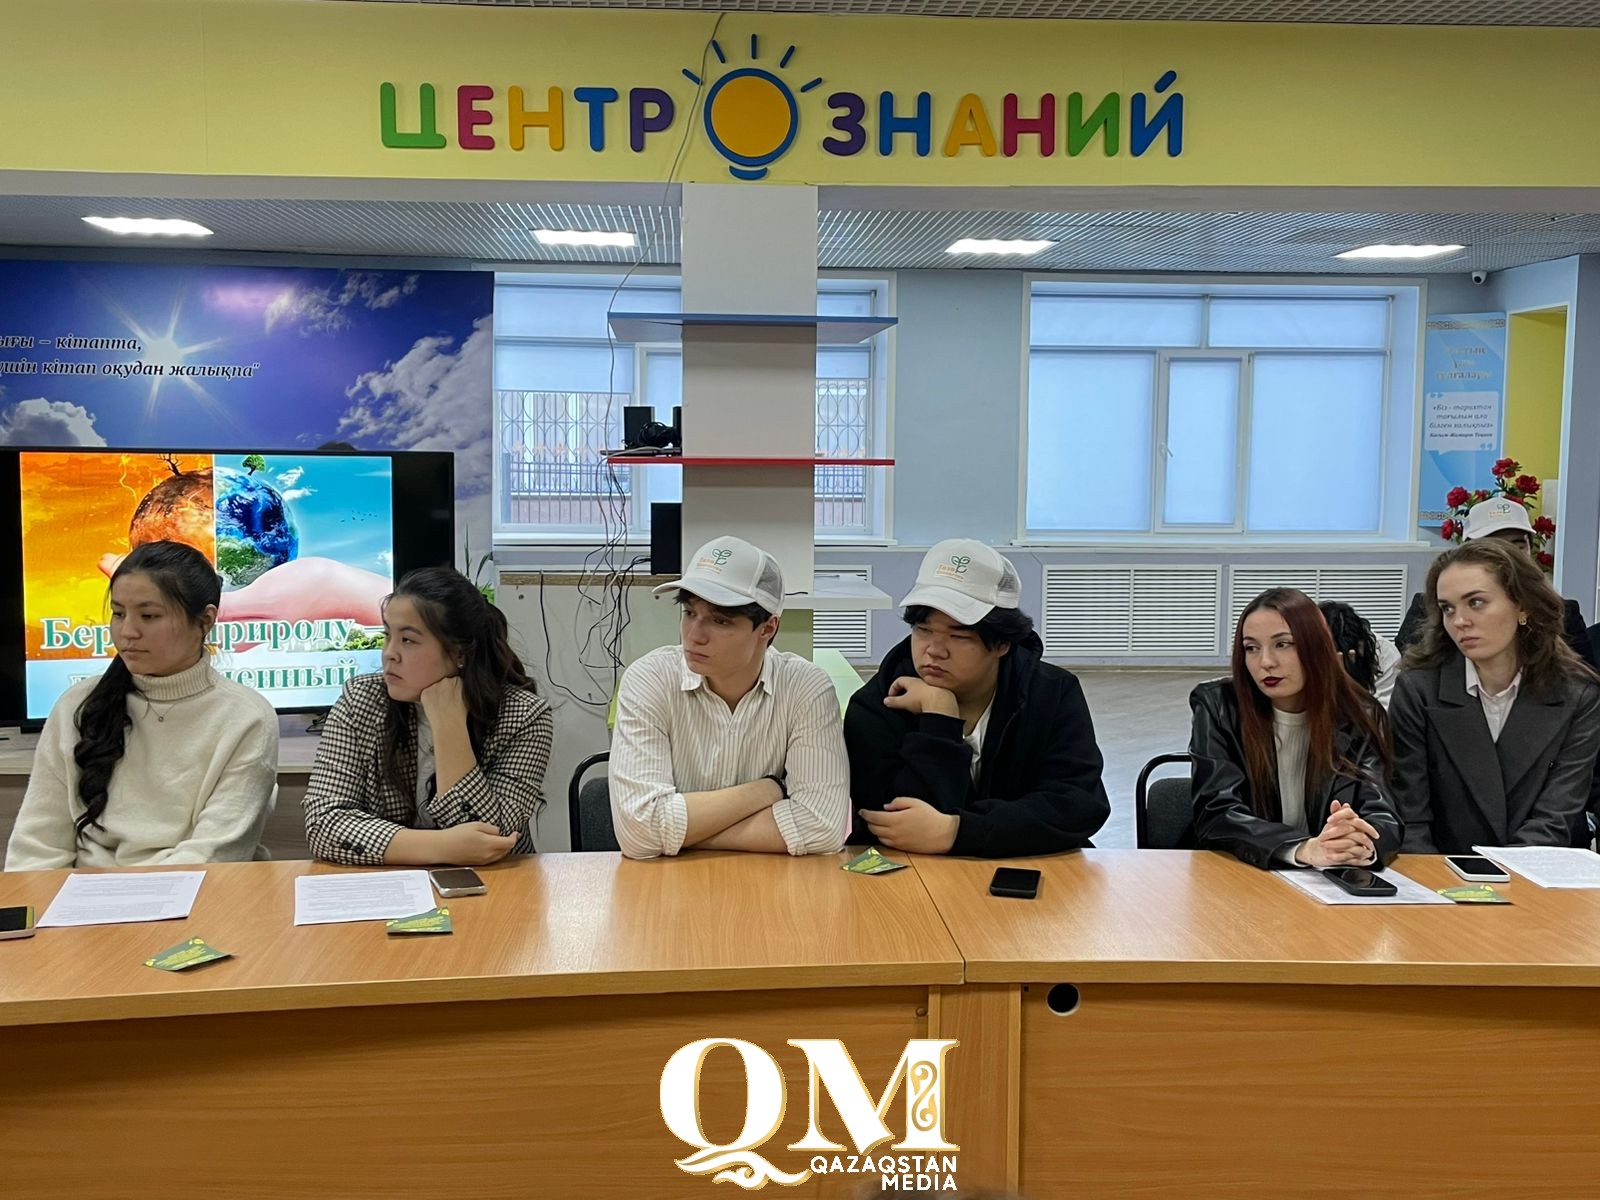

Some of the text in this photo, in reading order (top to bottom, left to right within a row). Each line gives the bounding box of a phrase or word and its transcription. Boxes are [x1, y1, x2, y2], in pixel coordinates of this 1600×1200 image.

[380, 70, 1184, 157] ЦЕНТР ЗНАНИЙ
[56, 333, 142, 352] кітапта,
[42, 358, 97, 375] кітап
[102, 360, 164, 379] оқудан
